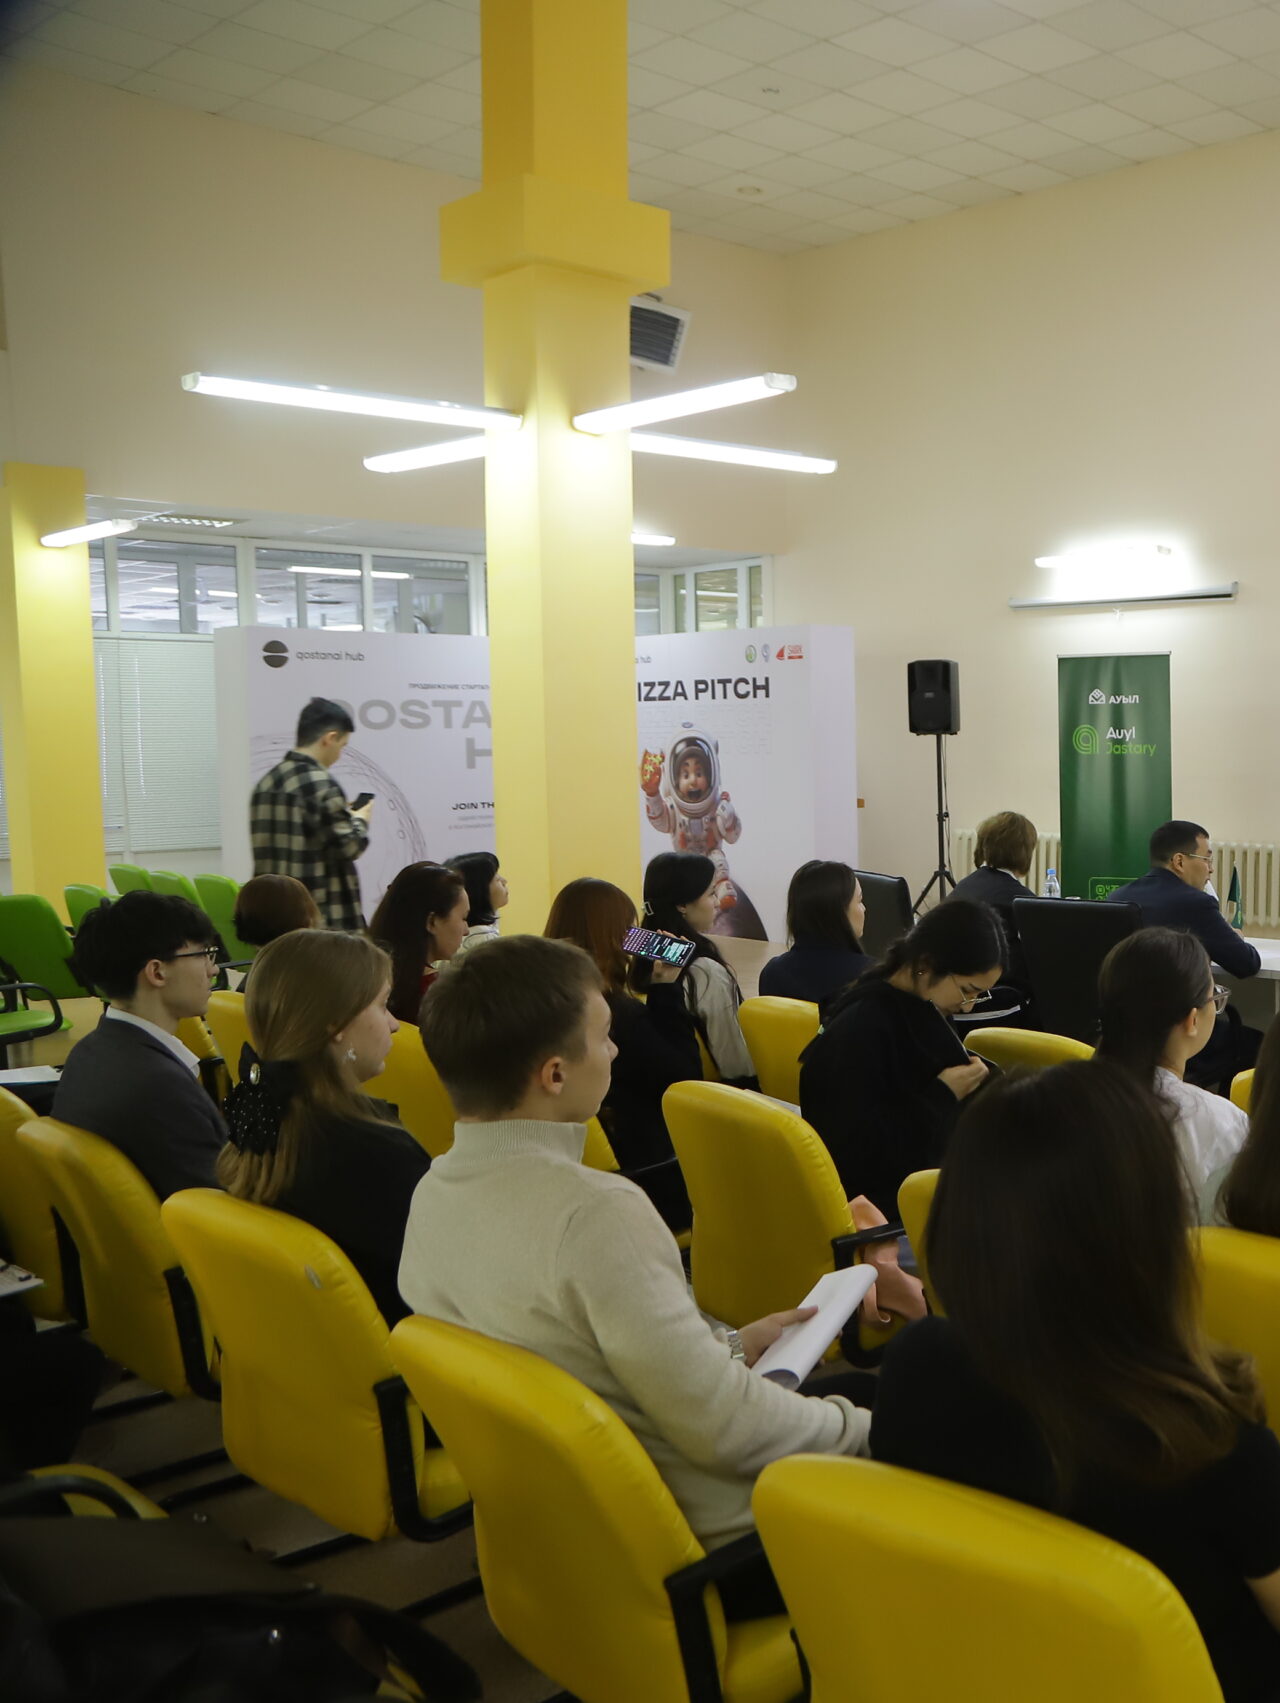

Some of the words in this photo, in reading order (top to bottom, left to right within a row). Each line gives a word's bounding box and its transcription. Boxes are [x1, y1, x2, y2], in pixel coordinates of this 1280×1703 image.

[296, 650, 343, 662] qostanai
[345, 651, 365, 661] hub
[693, 676, 770, 700] PITCH
[1109, 694, 1140, 705] АУЫЛ
[1106, 726, 1136, 742] Auyl
[1106, 742, 1157, 757] Jastary
[452, 802, 479, 811] JOIN
